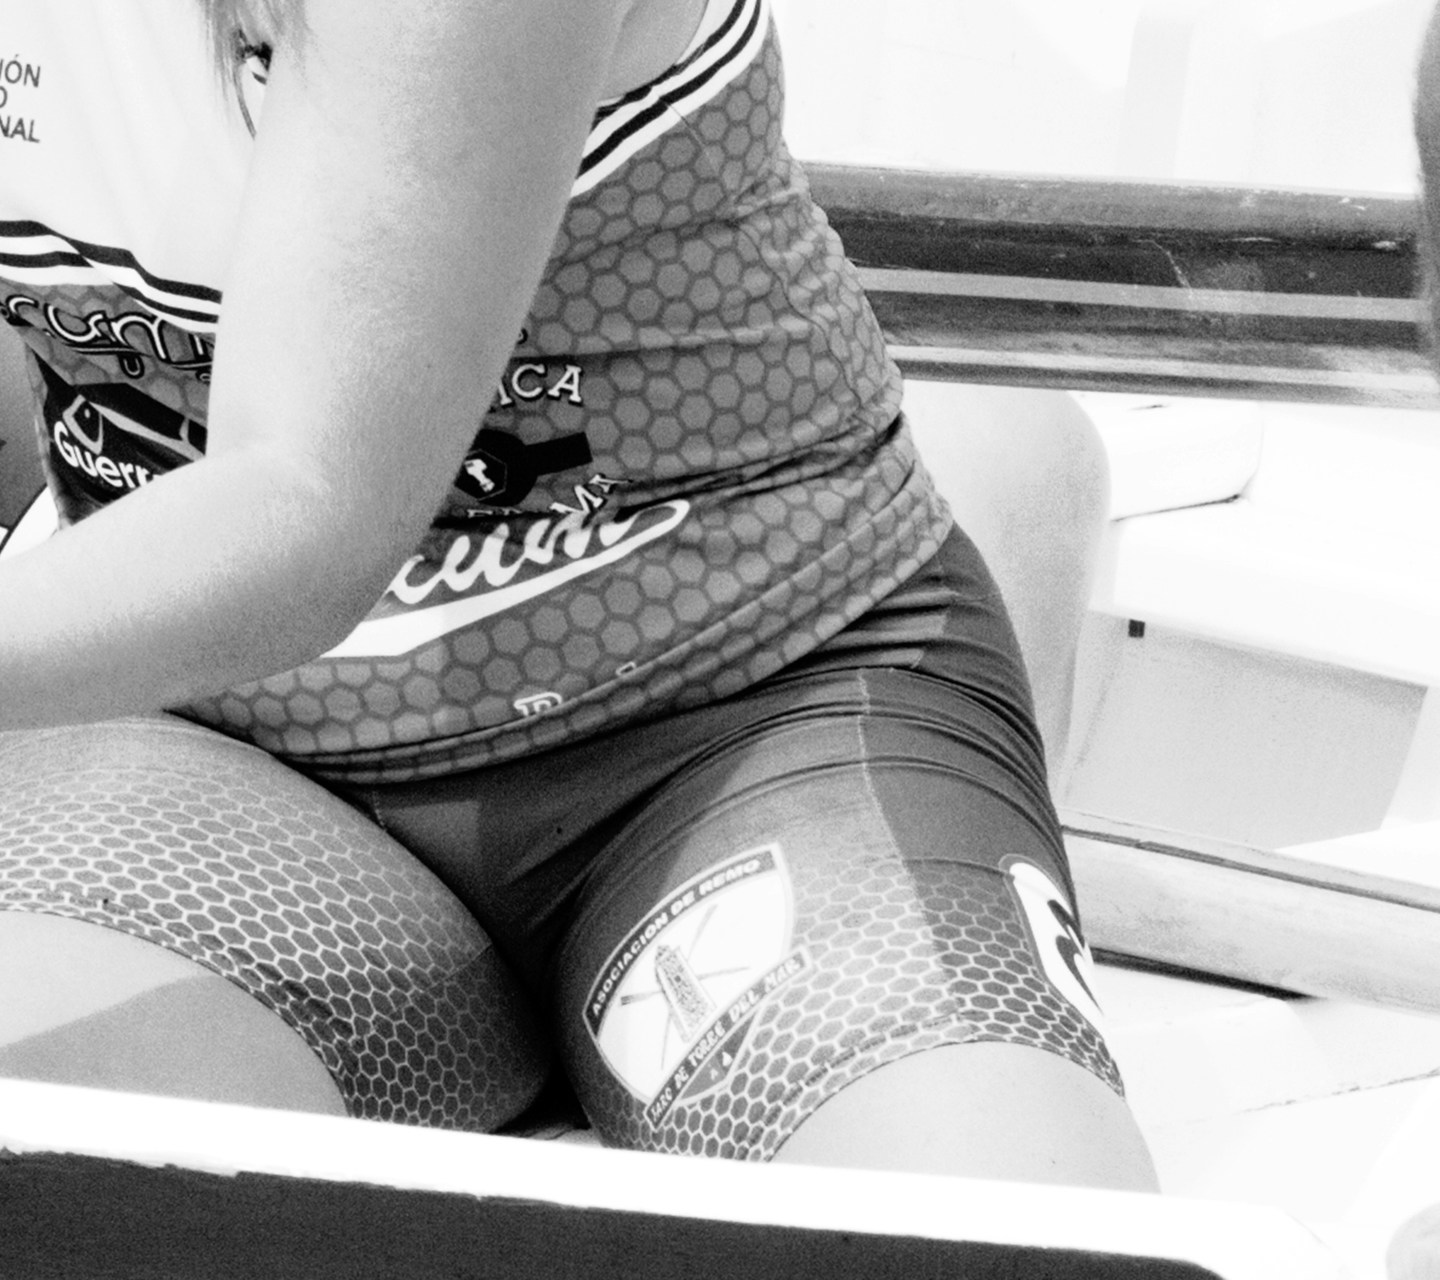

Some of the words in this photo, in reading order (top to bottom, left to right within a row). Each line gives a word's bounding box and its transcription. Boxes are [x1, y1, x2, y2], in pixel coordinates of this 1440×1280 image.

[53, 420, 157, 489] Guerr
[670, 891, 696, 916] DE
[698, 858, 762, 897] REMO
